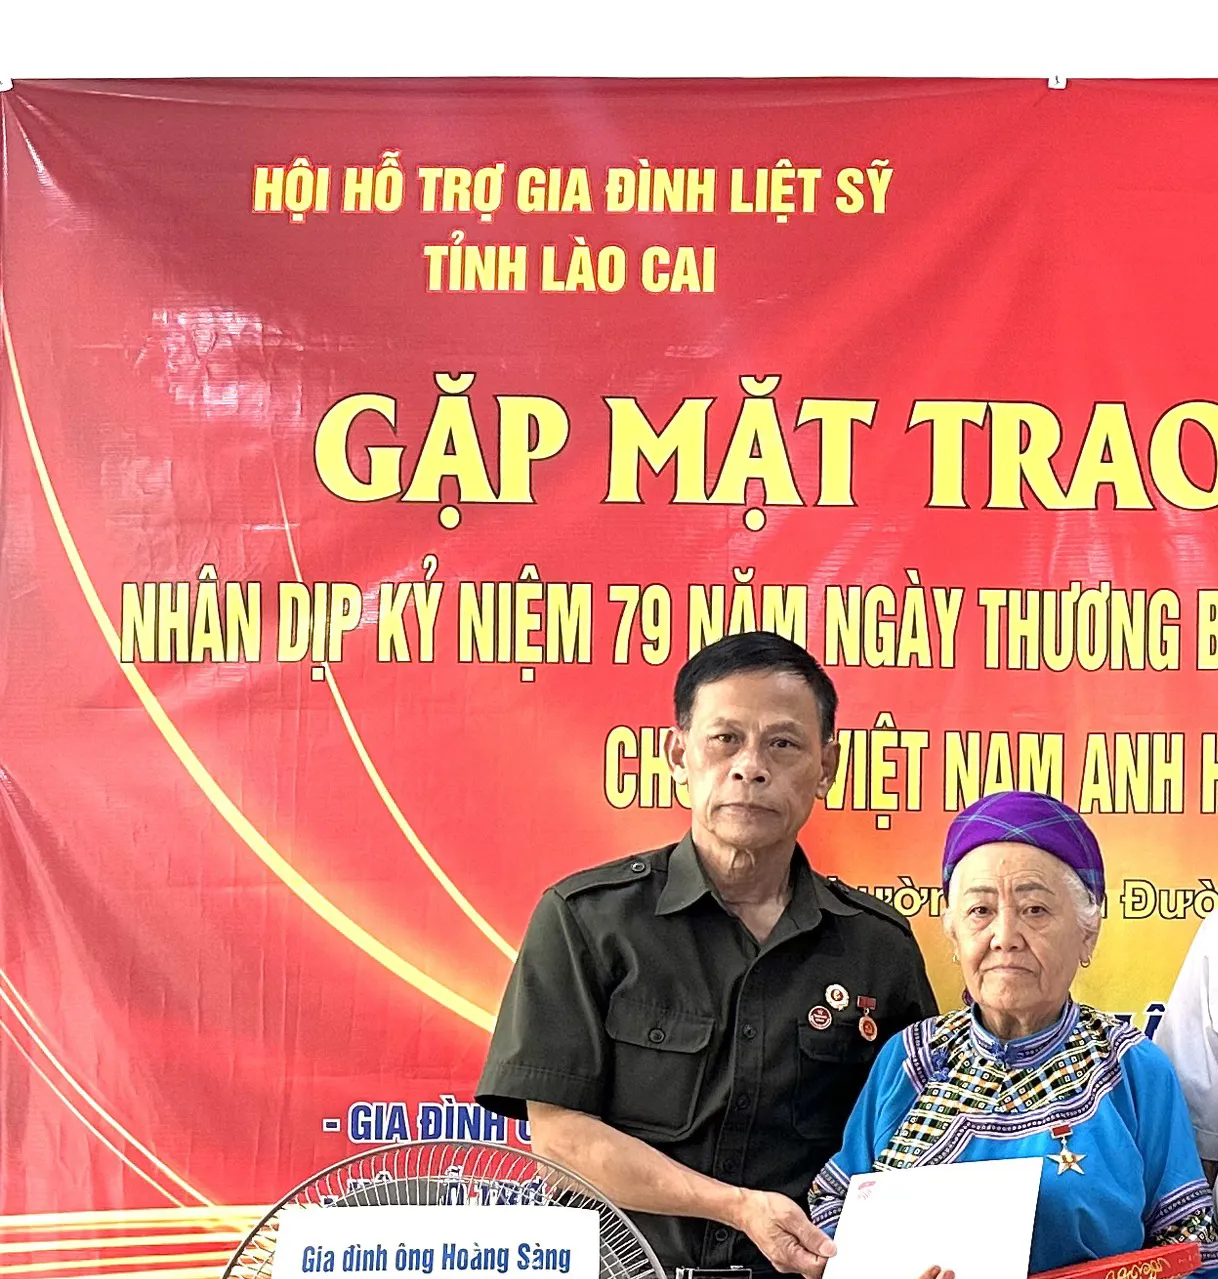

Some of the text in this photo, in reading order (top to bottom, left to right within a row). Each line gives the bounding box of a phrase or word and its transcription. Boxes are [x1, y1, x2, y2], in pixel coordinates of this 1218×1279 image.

[253, 150, 893, 223] HỘI HỖ TRỢ GIA ĐÌNH LIỆT SỸ
[423, 229, 716, 292] TỈNH LÀO CAI
[313, 371, 570, 529] GẶP
[602, 374, 878, 531] MẶT
[120, 564, 261, 664] NHÂN
[277, 583, 361, 683] DỊP
[377, 554, 444, 664] KỶ
[460, 565, 593, 683] NIỆM
[609, 583, 672, 667] 79
[824, 568, 965, 669] NGÀY
[978, 581, 1180, 672] THƯƠNG
[943, 730, 1063, 813] NAM
[1078, 731, 1184, 816] ANH
[348, 1102, 411, 1143] GIA
[418, 1095, 507, 1143] ĐÌNH
[301, 1241, 571, 1274] Gia đình ông Hoàng Sàng
